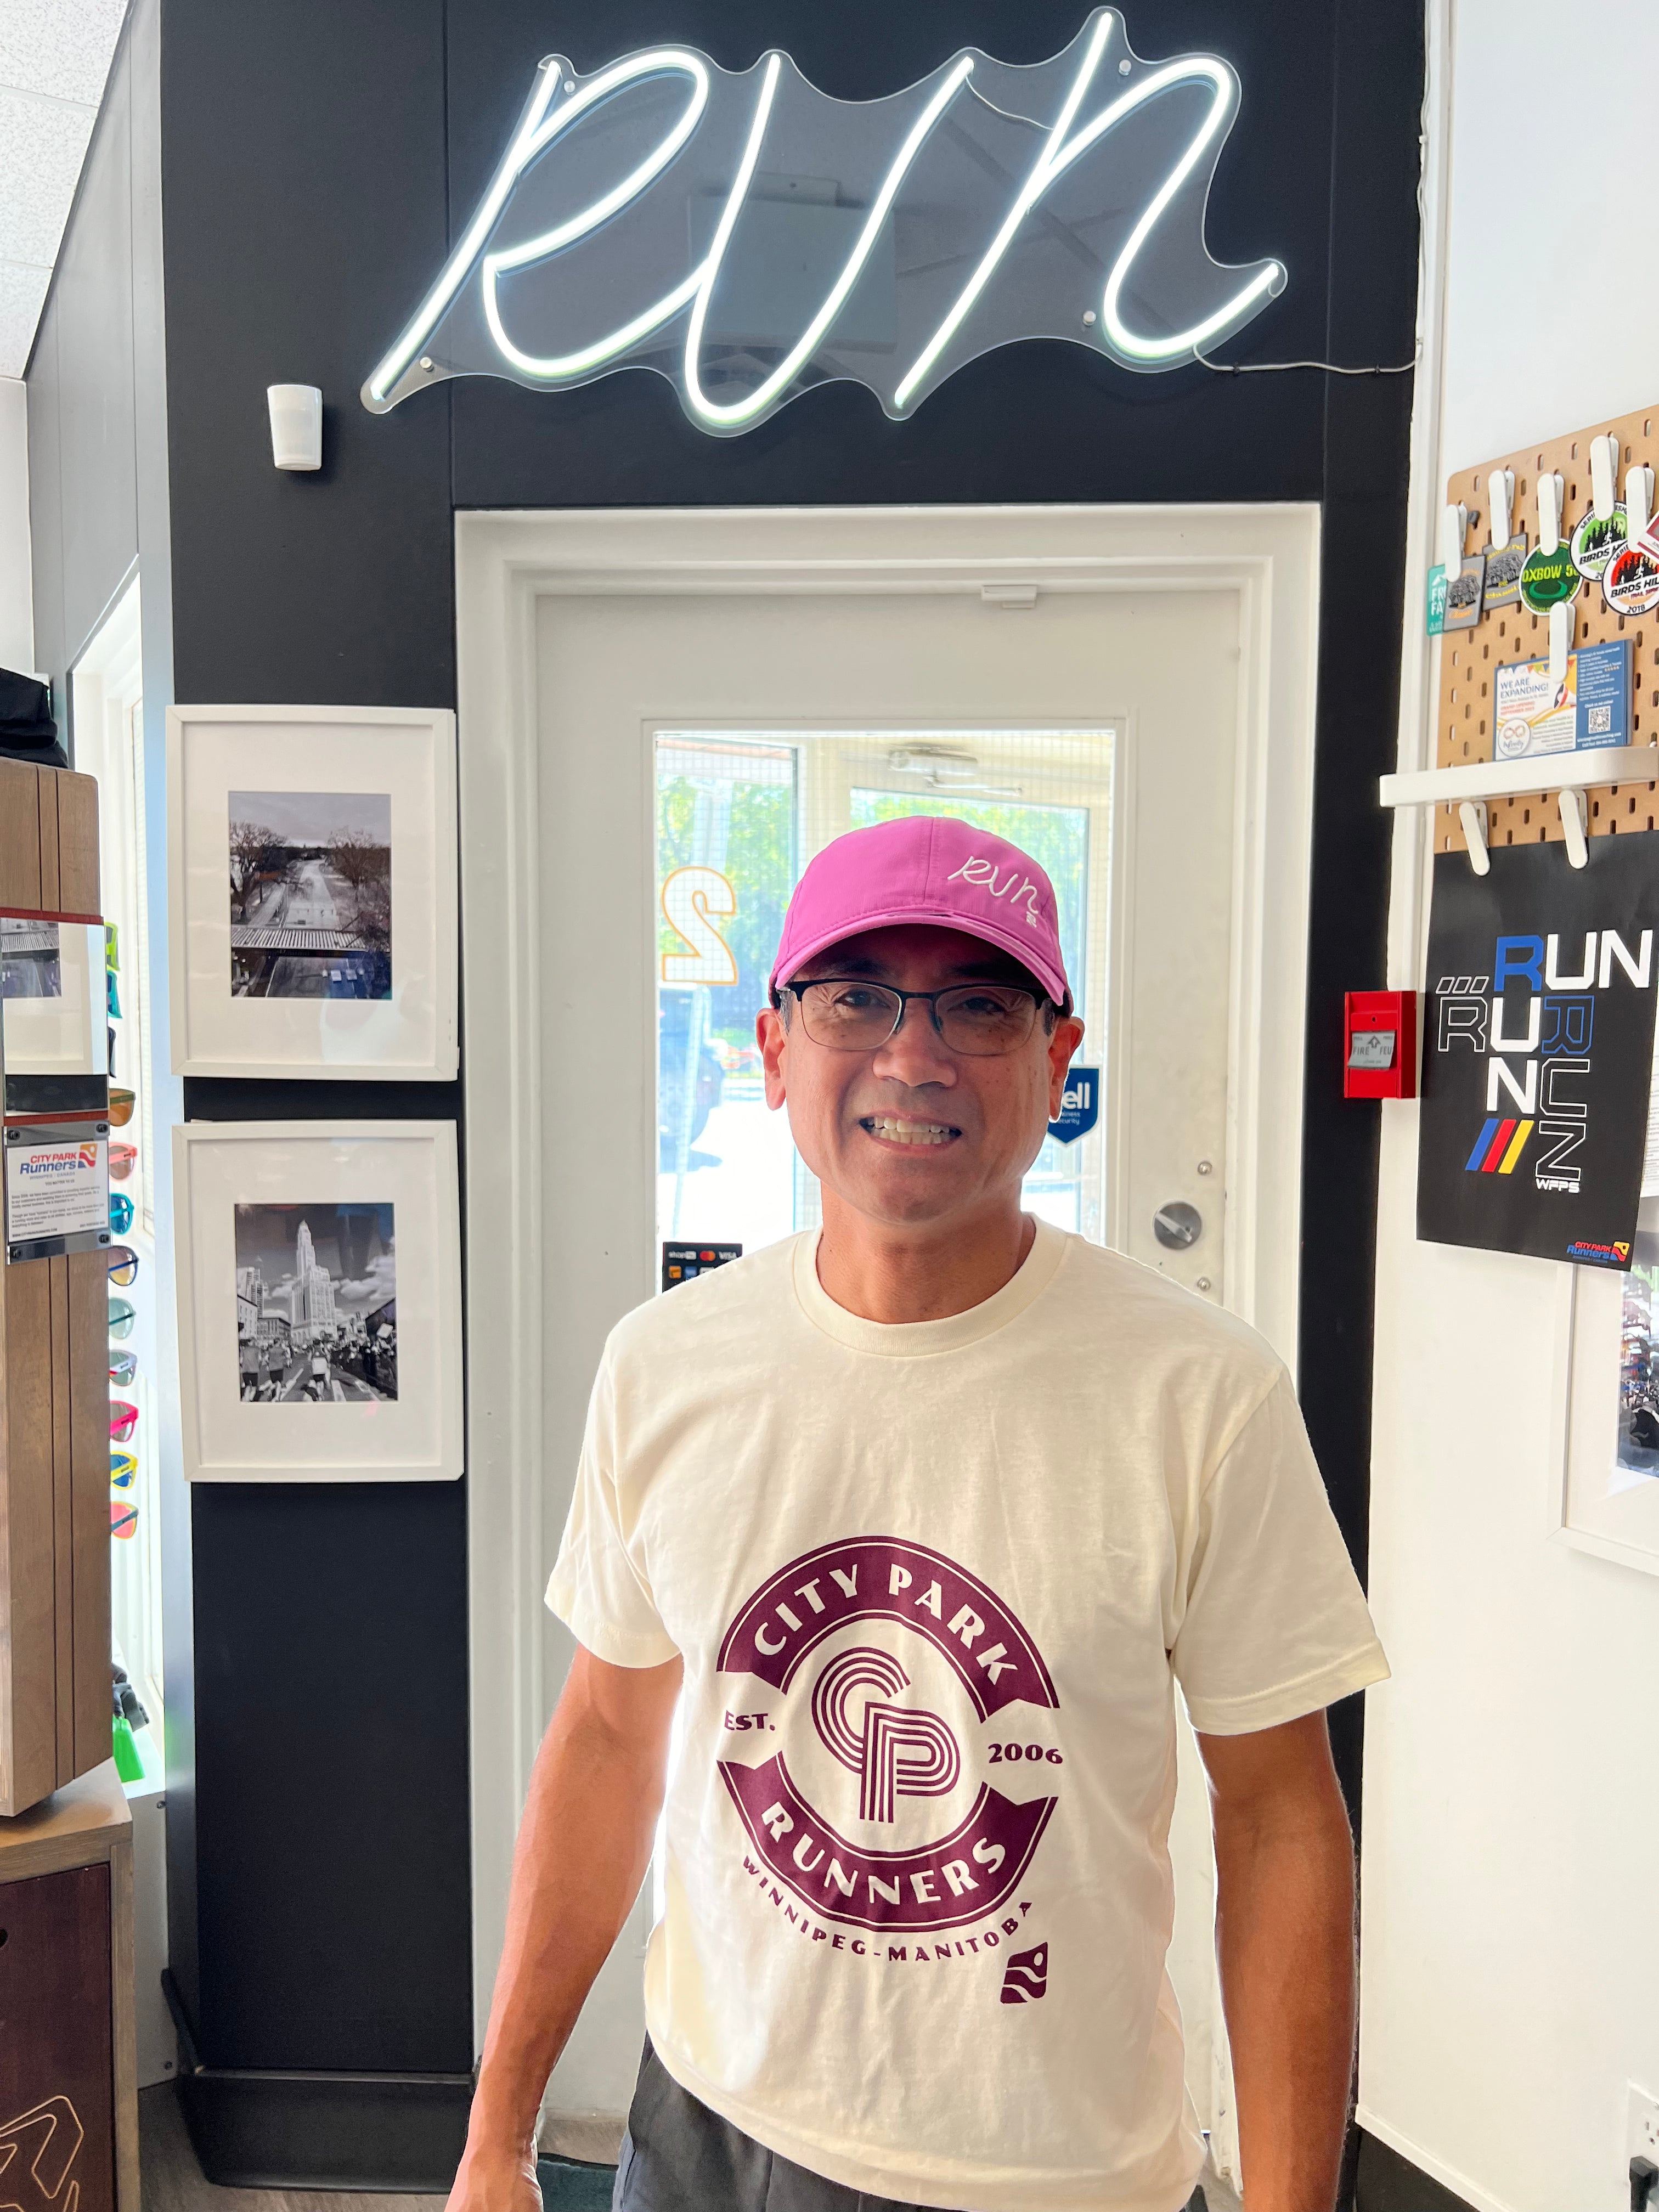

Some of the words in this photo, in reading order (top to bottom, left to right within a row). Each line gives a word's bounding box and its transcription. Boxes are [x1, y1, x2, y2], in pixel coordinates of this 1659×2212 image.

[1579, 548, 1610, 565] BIRDS
[1522, 563, 1562, 583] OXBOW
[1610, 584, 1641, 598] BIRDS
[1500, 680, 1514, 690] WE
[1515, 678, 1530, 686] ARE
[1500, 682, 1549, 699] EXPANDING!
[1494, 929, 1654, 992] RUN
[1353, 1046, 1370, 1056] FIRE
[1380, 1045, 1393, 1056] FEU
[1062, 1081, 1091, 1109] ell
[30, 1154, 53, 1164] CITY
[52, 1152, 77, 1161] PARK
[20, 1160, 77, 1175] Runners
[1536, 1178, 1581, 1194] WFPS
[1567, 1244, 1610, 1260] Runners
[1575, 1241, 1592, 1250] CITY
[1591, 1243, 1612, 1252] PARK
[754, 1564, 859, 1656] CITY
[888, 1563, 1018, 1686] PARK
[724, 1710, 776, 1731] EST.
[988, 1743, 1064, 1765] 2006
[761, 1801, 1006, 1905] RUNNERS
